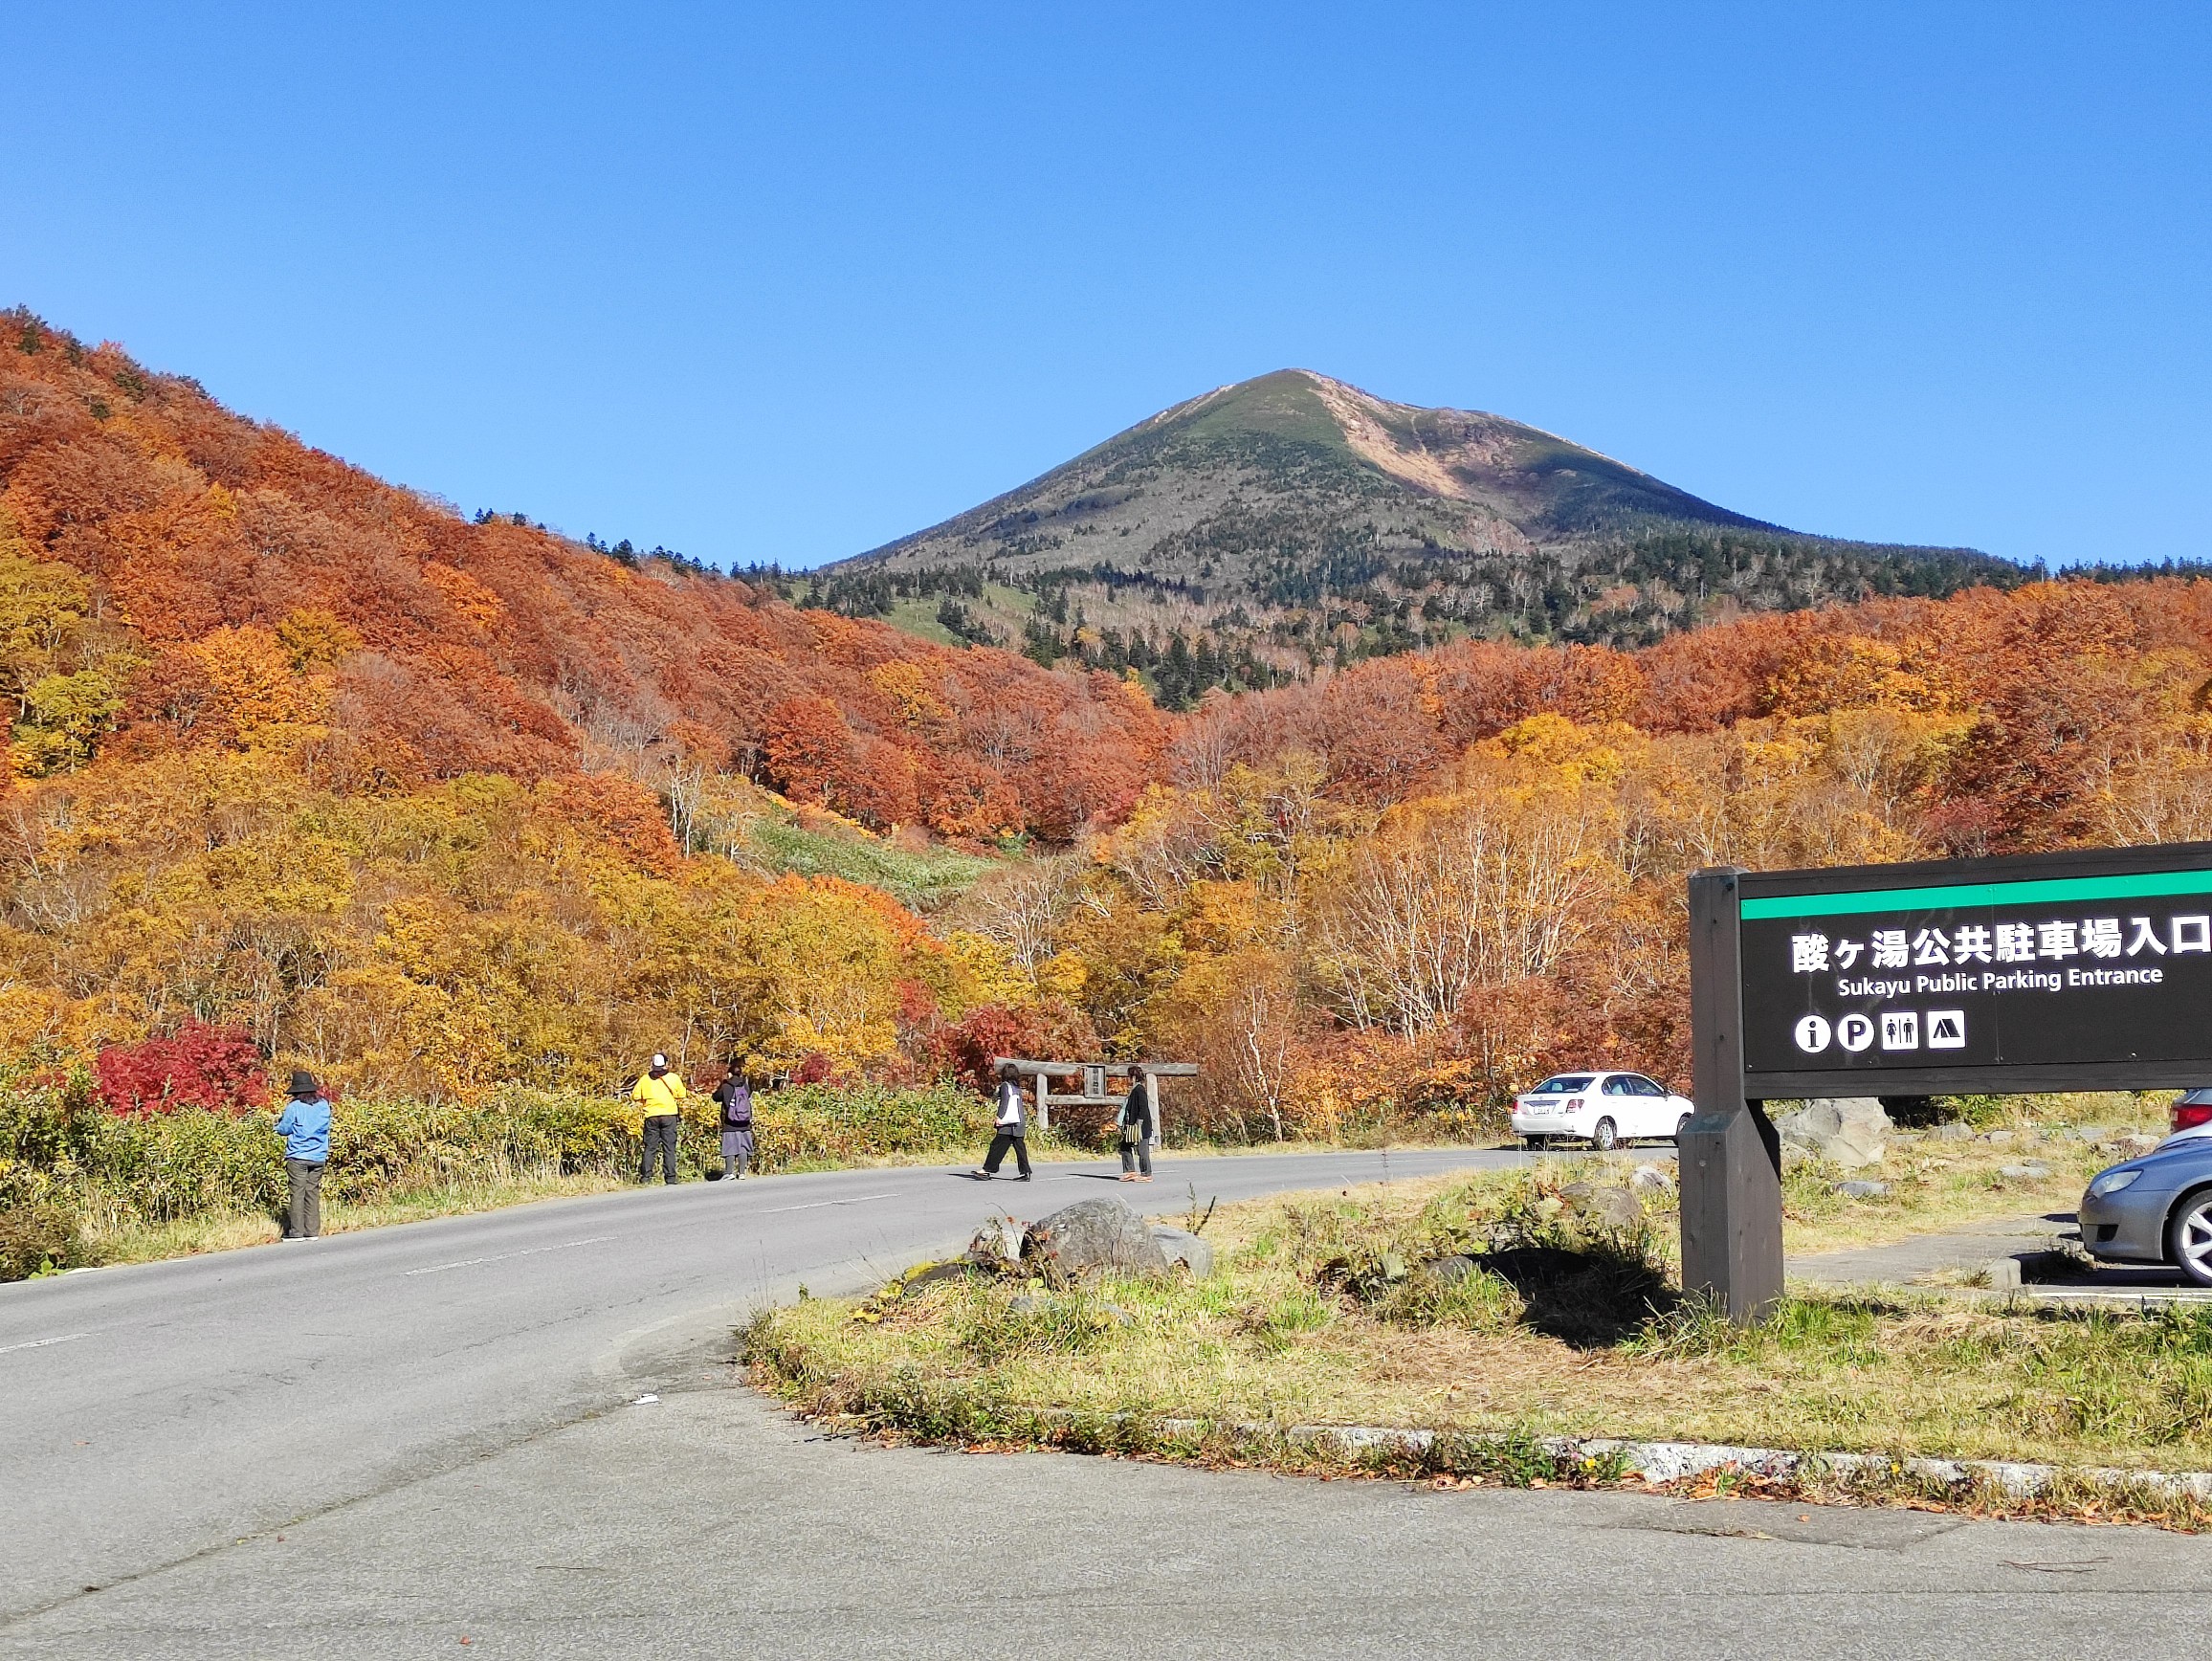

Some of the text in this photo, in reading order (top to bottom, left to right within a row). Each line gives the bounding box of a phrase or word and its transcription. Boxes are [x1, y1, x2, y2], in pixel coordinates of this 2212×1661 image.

[1837, 967, 2164, 999] Sukayu Public Parking Entrance
